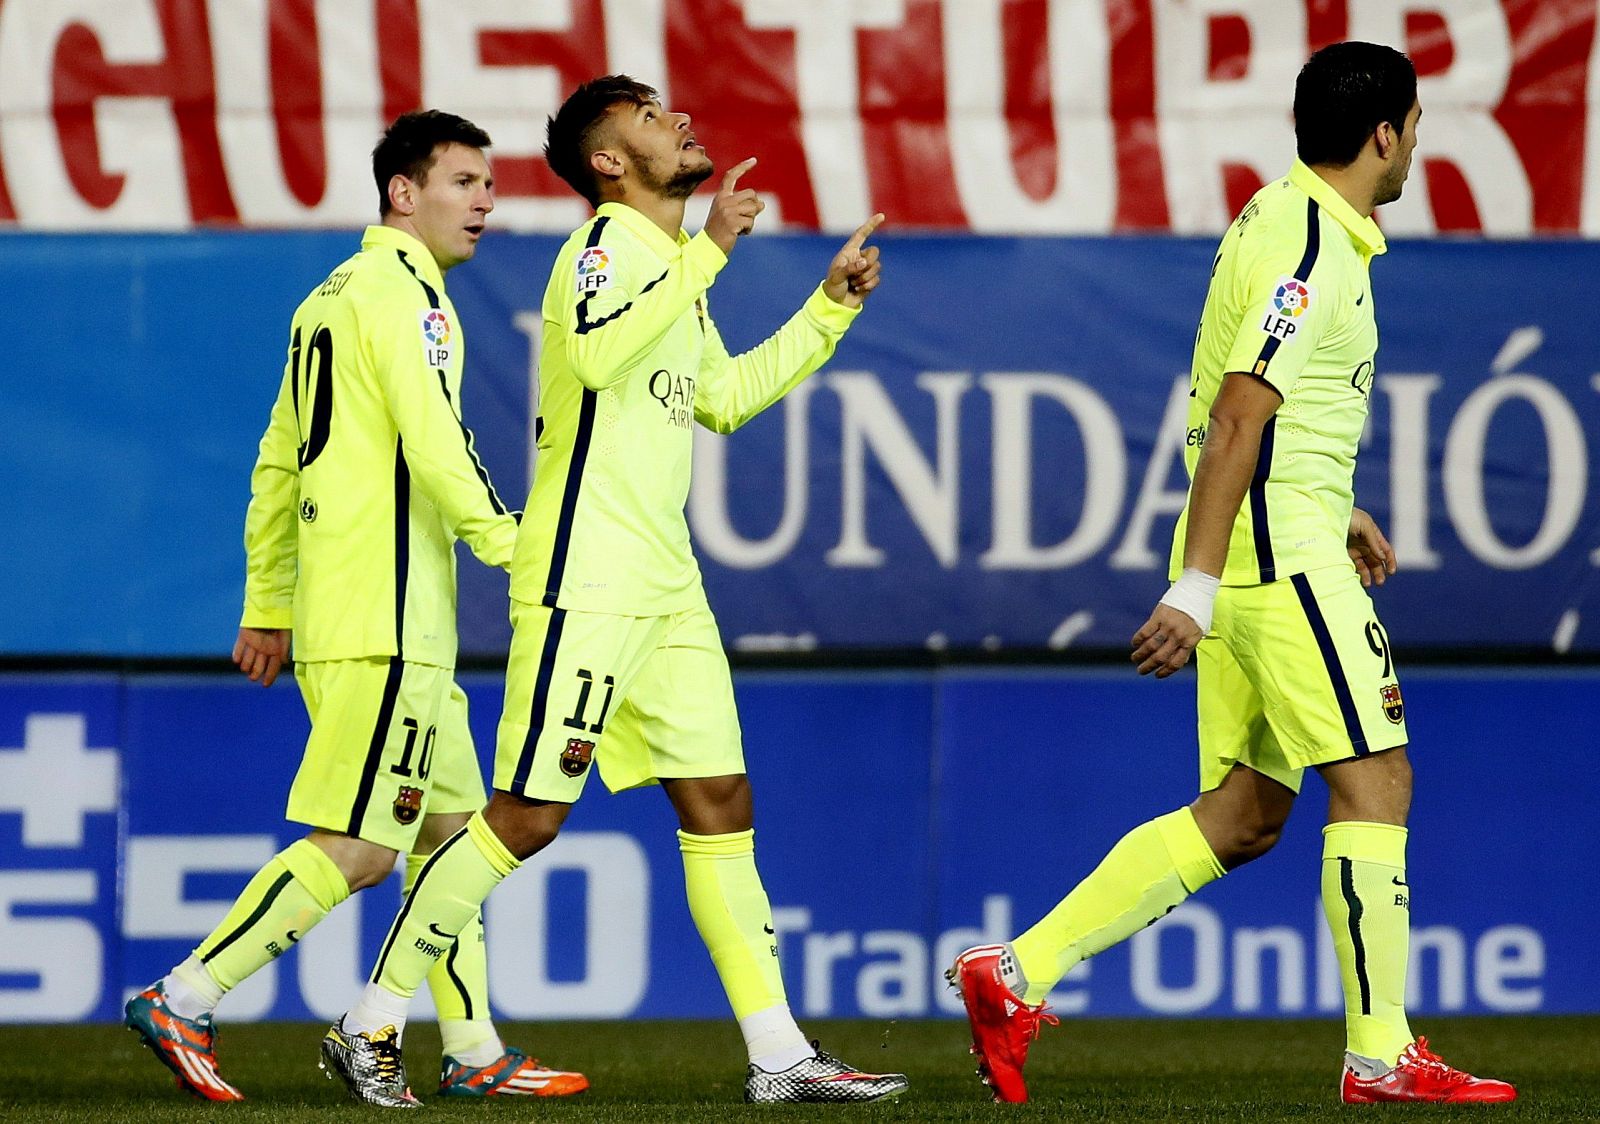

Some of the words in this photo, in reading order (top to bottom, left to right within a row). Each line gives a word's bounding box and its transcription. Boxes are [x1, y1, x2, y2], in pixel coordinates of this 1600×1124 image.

[577, 274, 608, 293] LFP
[1263, 314, 1297, 339] LFP
[428, 349, 449, 367] LFP
[1364, 620, 1391, 679] 9
[562, 667, 615, 735] 11
[389, 716, 437, 782] 10
[1129, 898, 1545, 1014] Onlne
